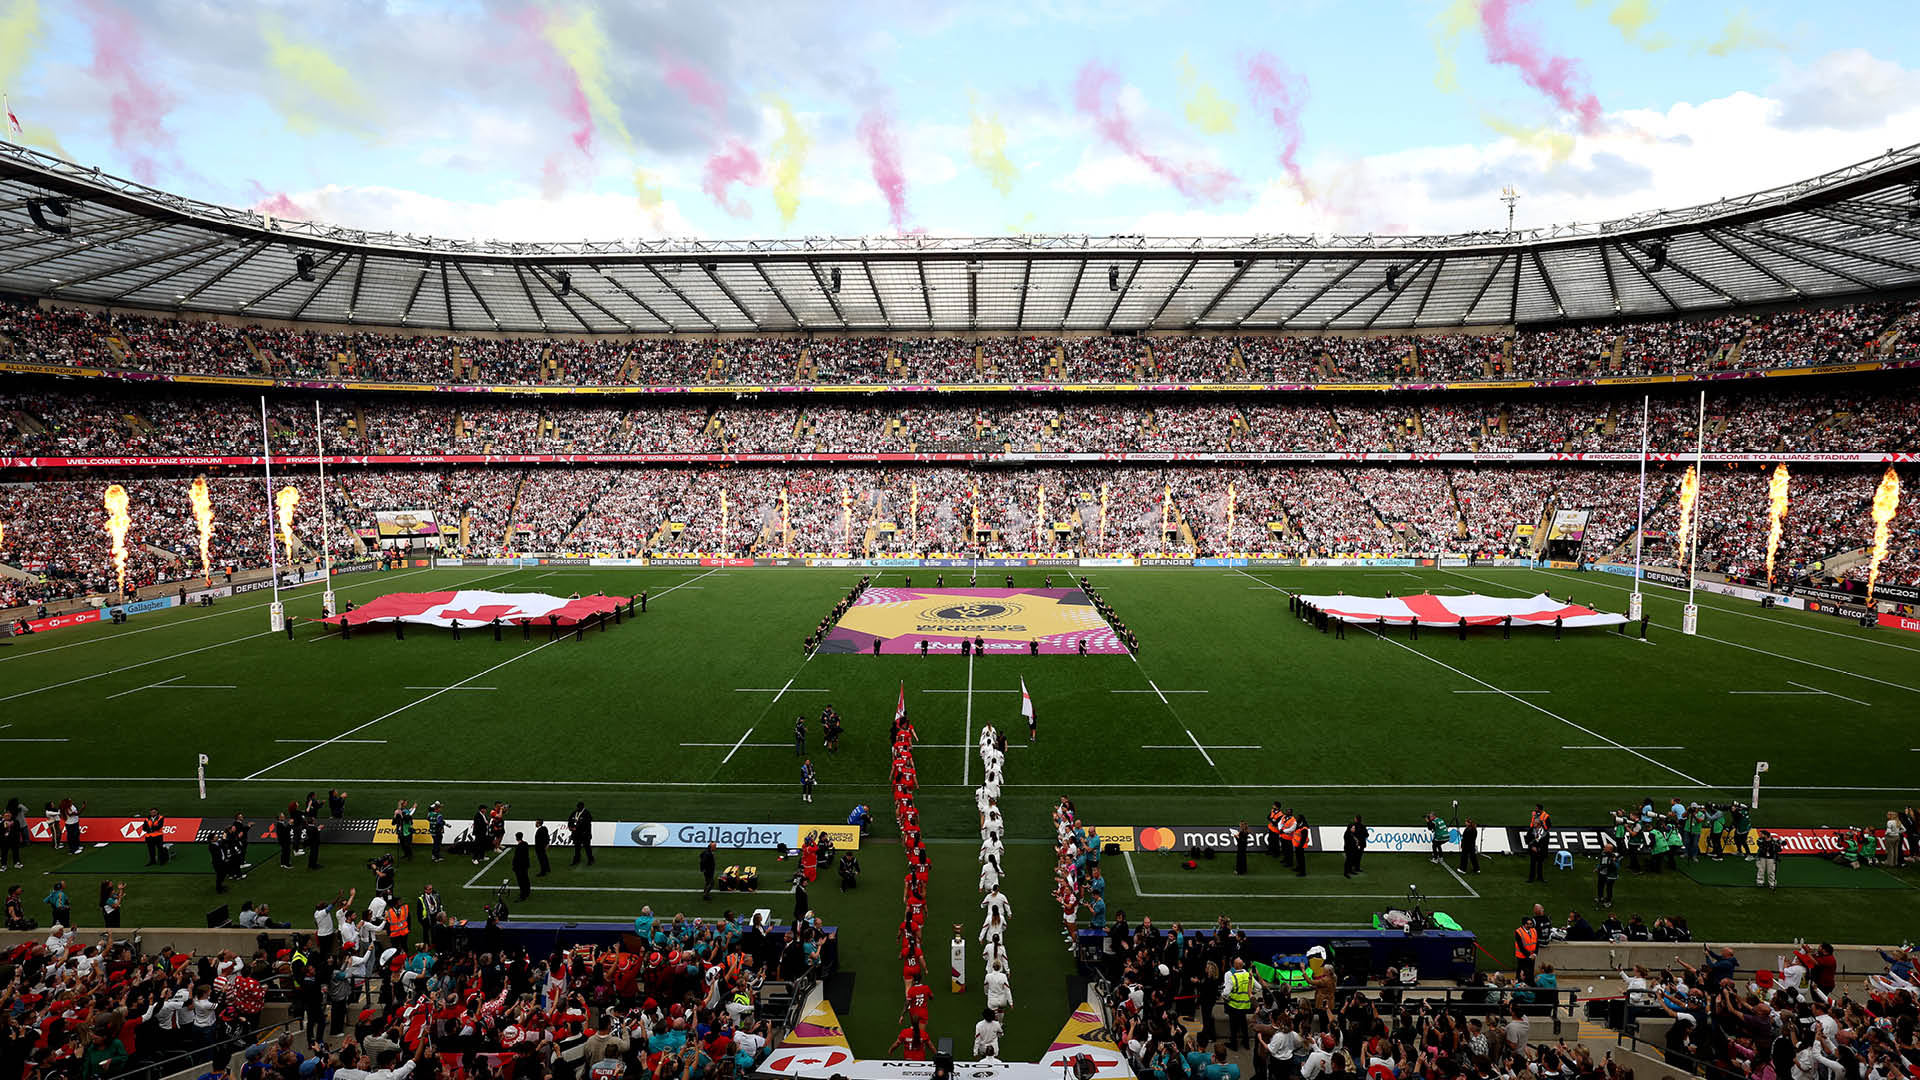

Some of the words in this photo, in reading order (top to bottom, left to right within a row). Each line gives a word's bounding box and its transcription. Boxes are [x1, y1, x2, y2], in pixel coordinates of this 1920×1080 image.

[5, 364, 42, 372] ALLIANZ
[44, 367, 83, 375] STADIUM
[1811, 366, 1857, 374] #RWC2025
[338, 563, 373, 573] mastercard
[1807, 589, 1829, 598] NEVER
[127, 601, 164, 613] Gallagher
[1821, 604, 1866, 618] matercar
[678, 826, 782, 848] Gallagher
[1366, 828, 1434, 850] Capgemi
[1768, 832, 1845, 851] mirate
